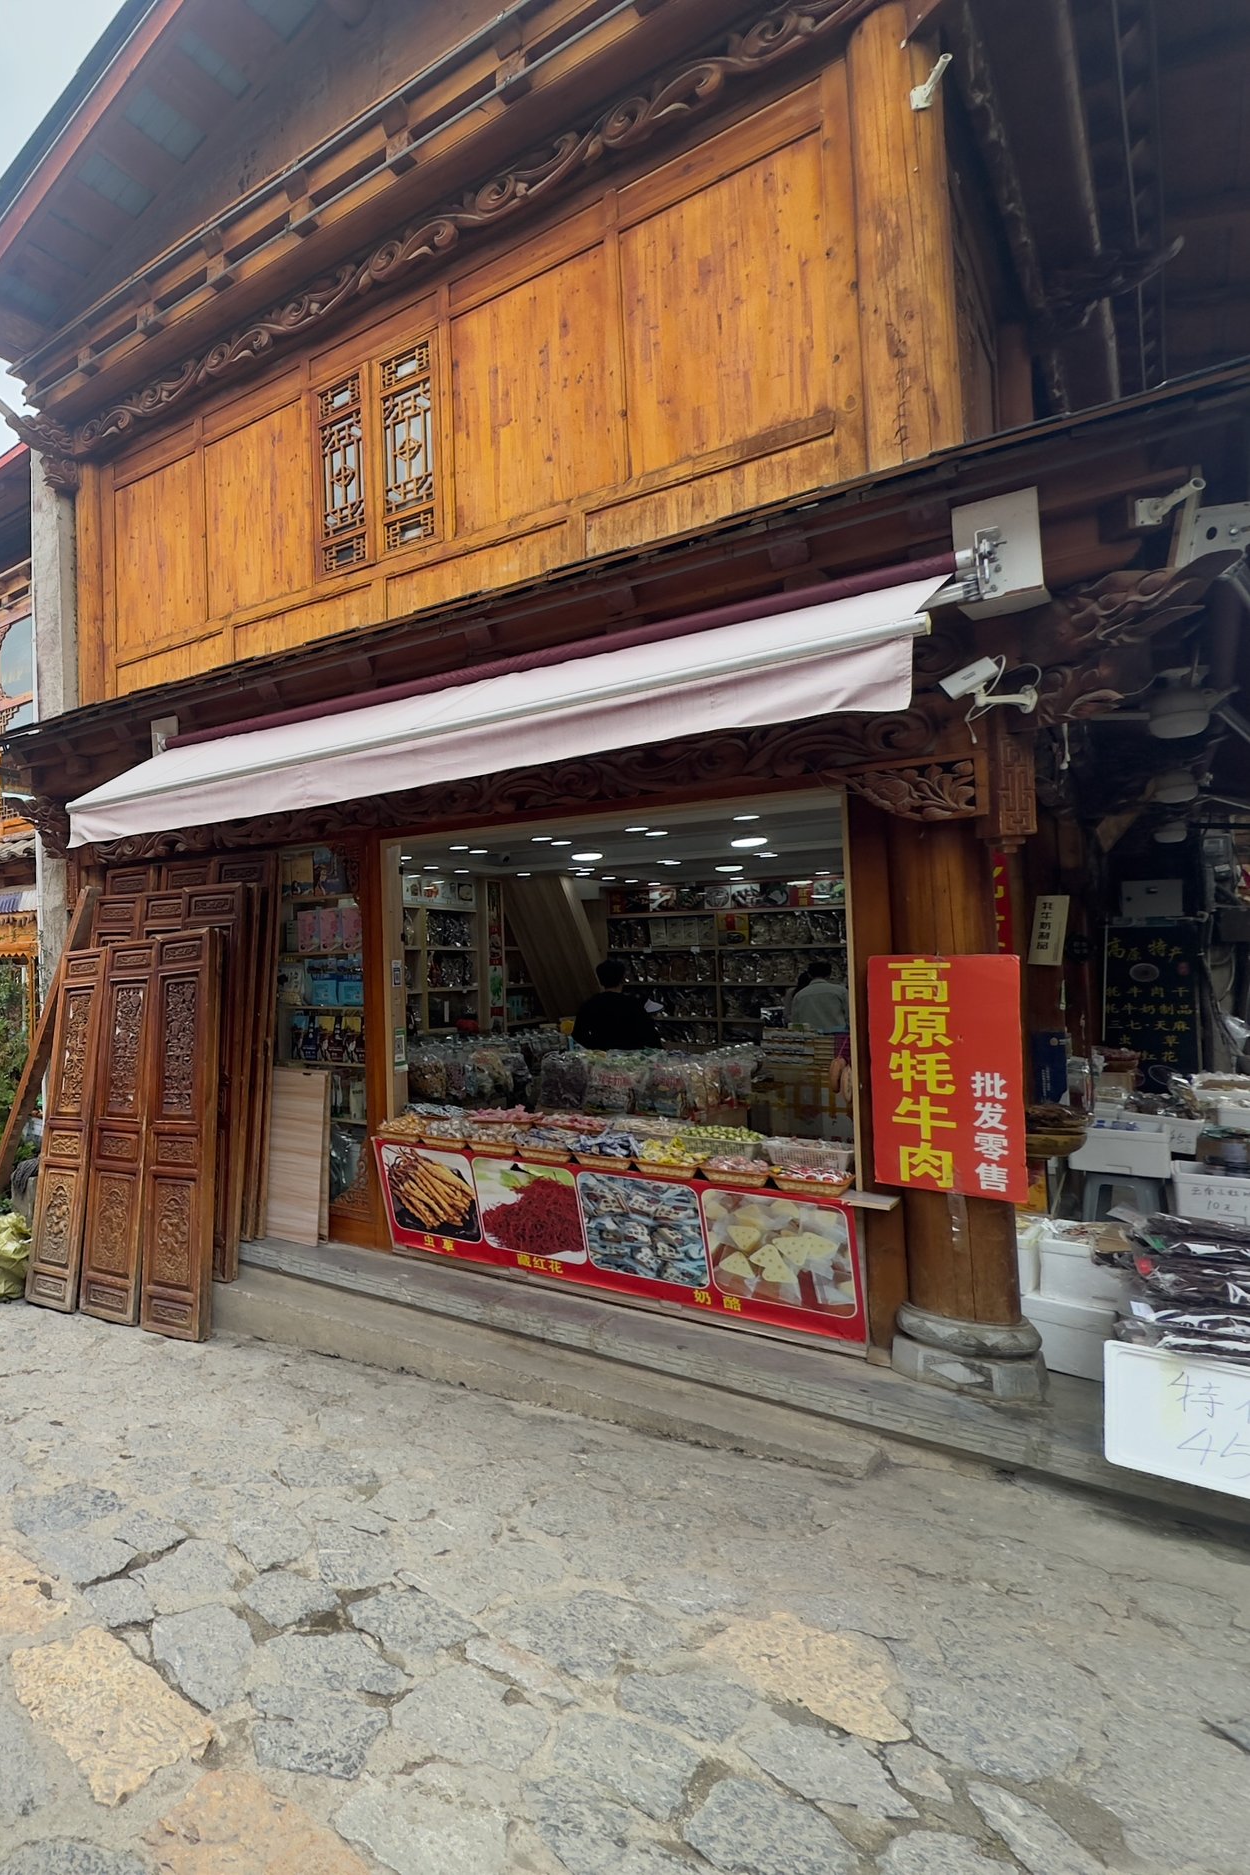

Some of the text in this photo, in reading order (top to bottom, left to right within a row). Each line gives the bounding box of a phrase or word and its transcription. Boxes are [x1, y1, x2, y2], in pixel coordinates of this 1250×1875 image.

[1107, 938, 1183, 962] 高原特产
[1106, 986, 1190, 998] 牦牛肉干
[1105, 1004, 1193, 1015] 牦牛奶制品
[1140, 1051, 1179, 1062] 红花
[887, 959, 957, 1191] 高原牦牛肉
[970, 1070, 1010, 1194] 批发零售
[423, 1234, 456, 1253] 虫草
[516, 1254, 564, 1274] 藏红花
[693, 1289, 743, 1313] 奶酪
